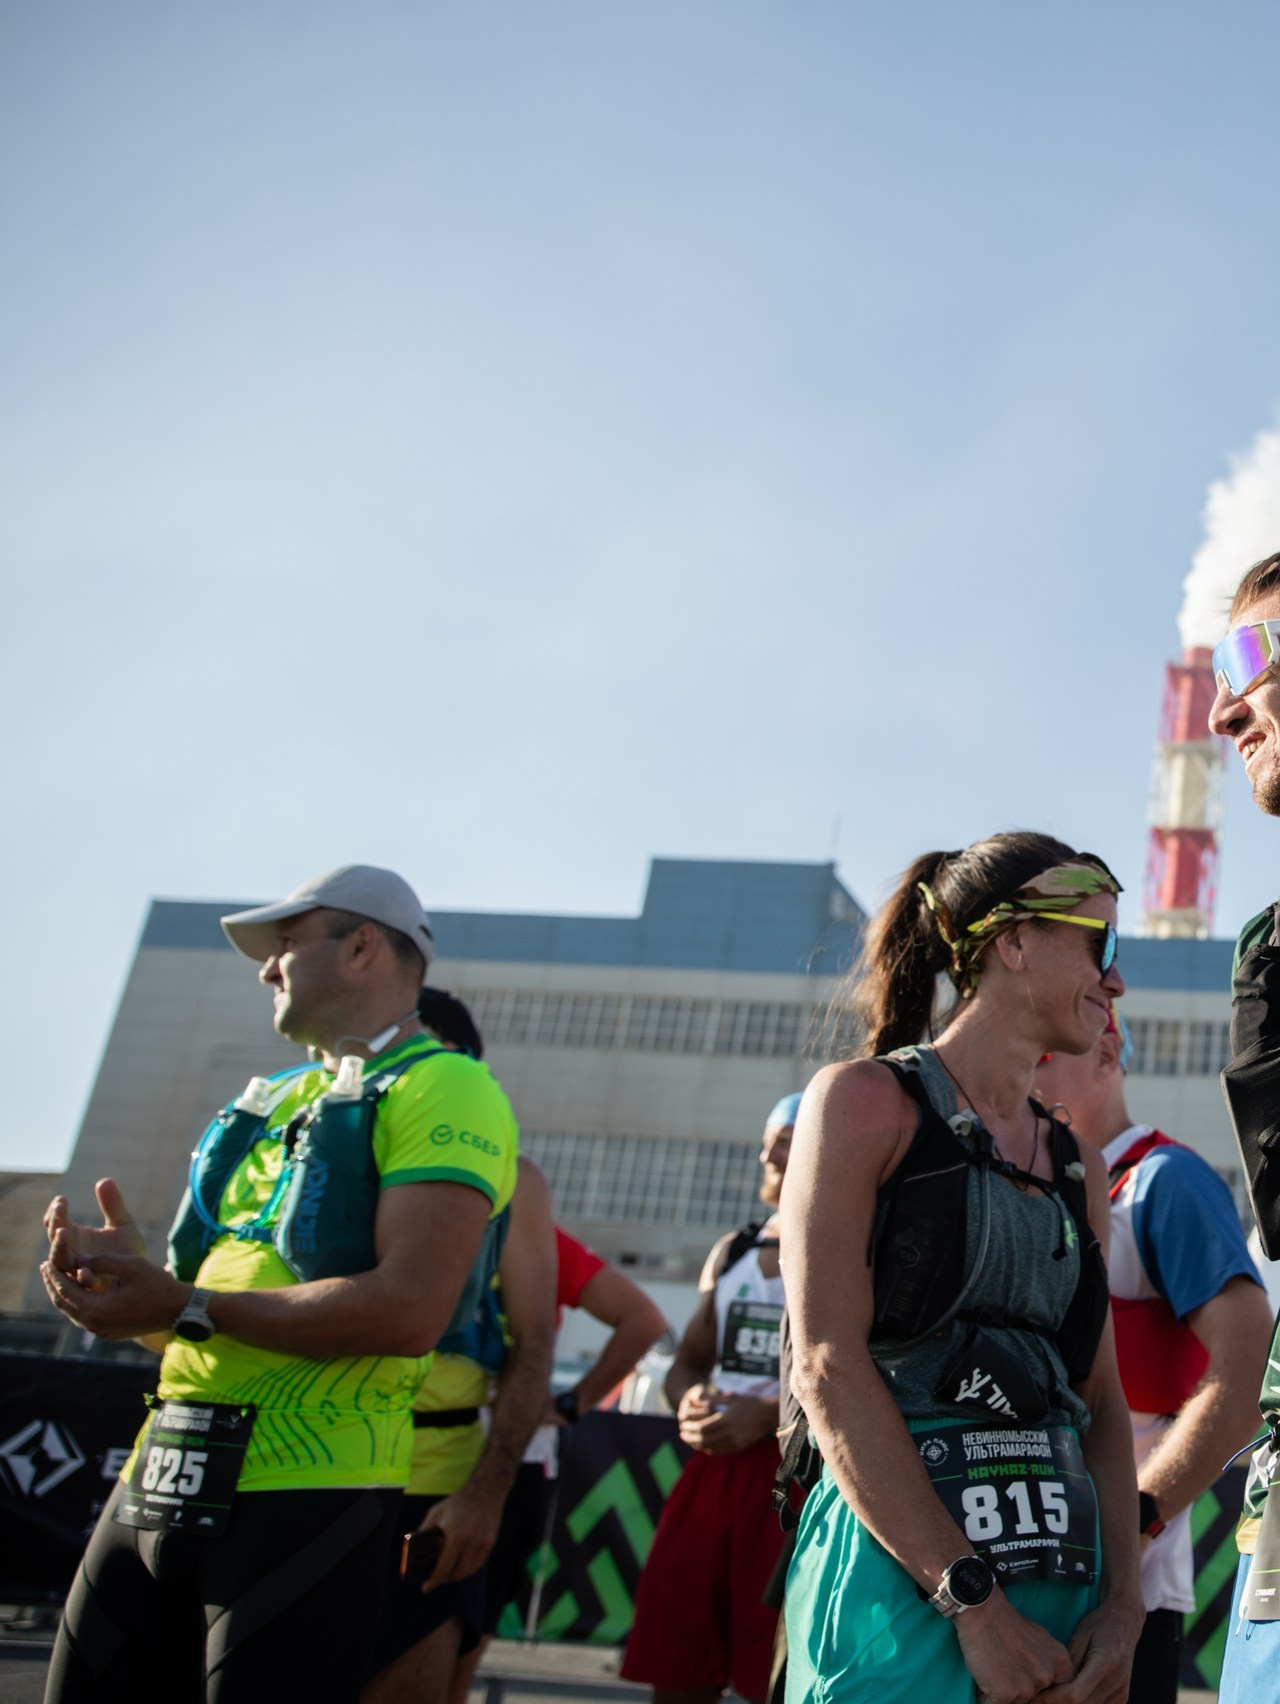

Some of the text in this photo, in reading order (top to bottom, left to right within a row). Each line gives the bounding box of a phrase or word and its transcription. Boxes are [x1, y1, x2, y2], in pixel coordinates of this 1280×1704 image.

[962, 1430, 1050, 1447] НЕВИННОМЫССКИЙ
[964, 1443, 1052, 1461] УЛЬТРАМАРАФОН
[142, 1446, 208, 1496] 825
[961, 1481, 1069, 1542] 815
[990, 1538, 1060, 1554] УЛЬТРАМАРАФОН
